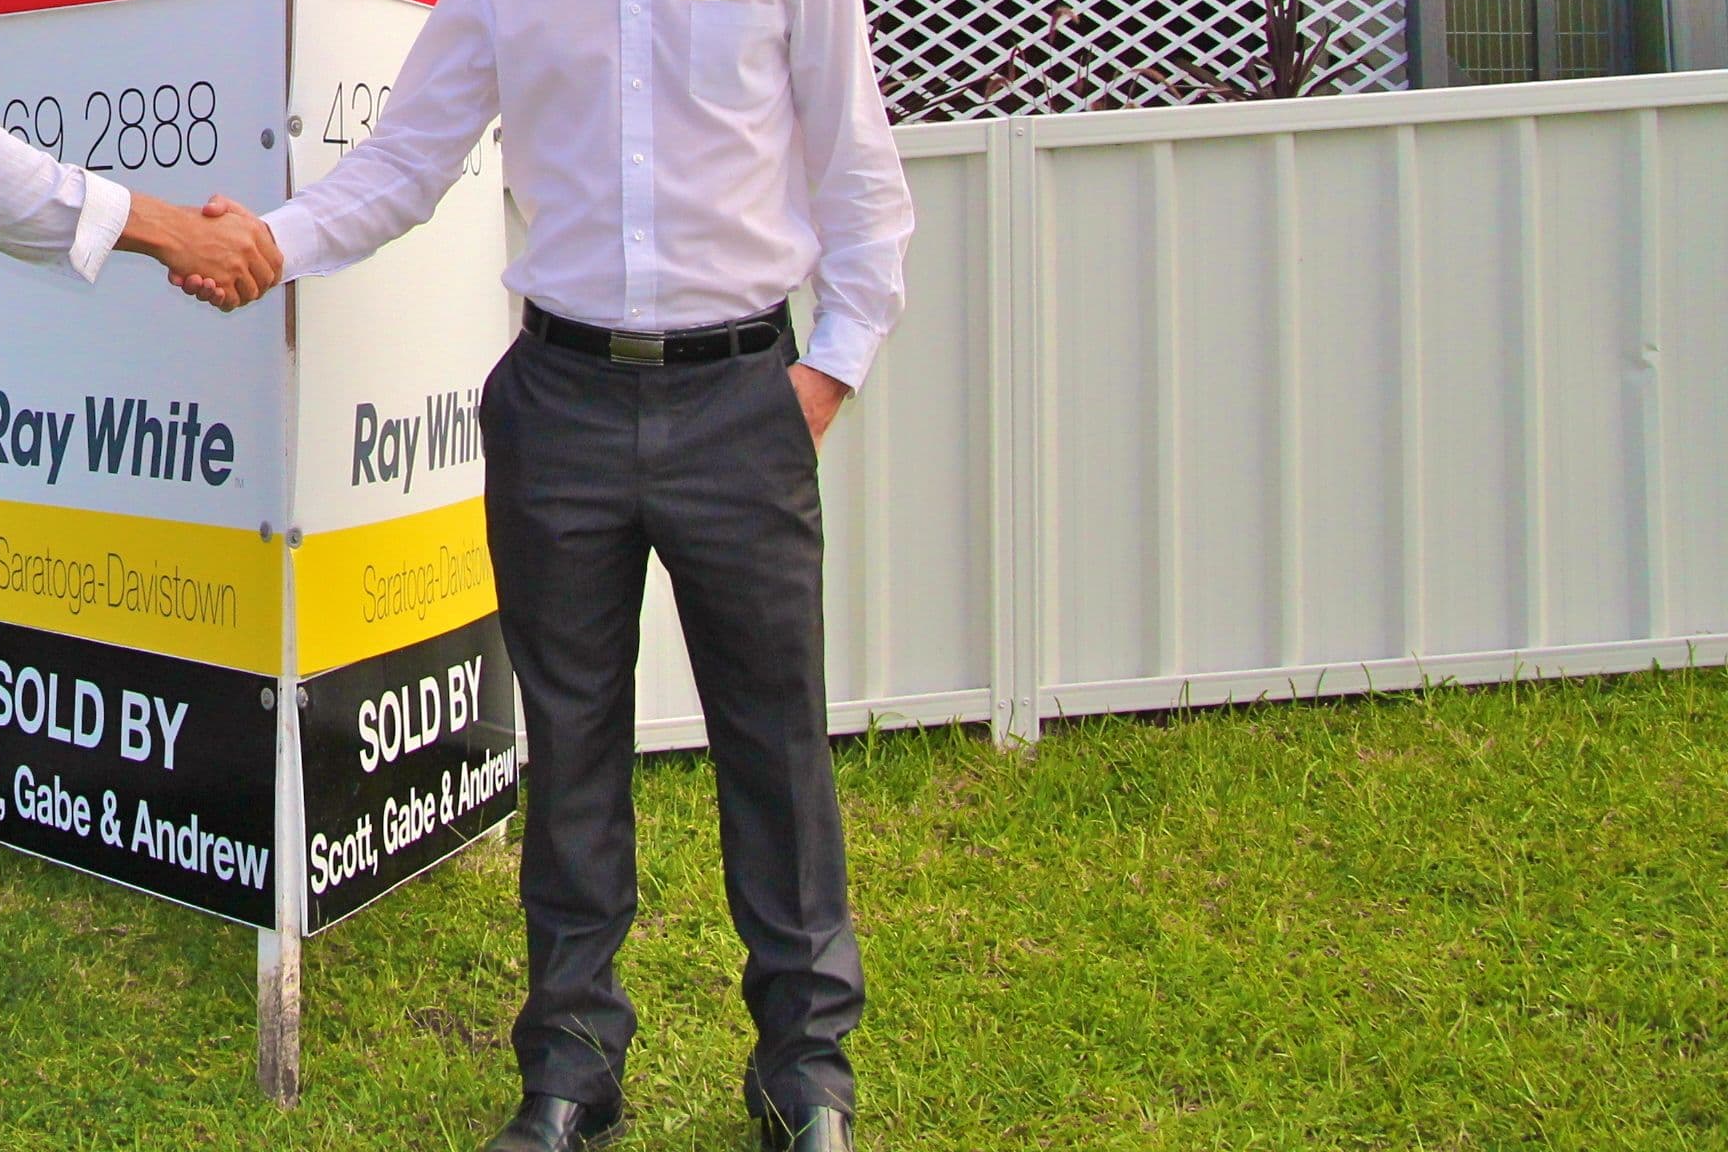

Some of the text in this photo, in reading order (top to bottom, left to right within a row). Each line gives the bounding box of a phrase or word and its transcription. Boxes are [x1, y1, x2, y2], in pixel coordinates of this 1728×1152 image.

[84, 80, 218, 171] 2888
[85, 395, 235, 487] White
[351, 388, 485, 495] Ray Whit
[363, 538, 491, 623] Saratoga-Davistow
[120, 689, 189, 770] BY
[358, 655, 482, 773] SOLD BY
[13, 764, 91, 837] Gabe
[99, 789, 124, 848] &
[130, 799, 269, 890] Andrew
[310, 746, 515, 895] Scott, Gabe & Andrew
